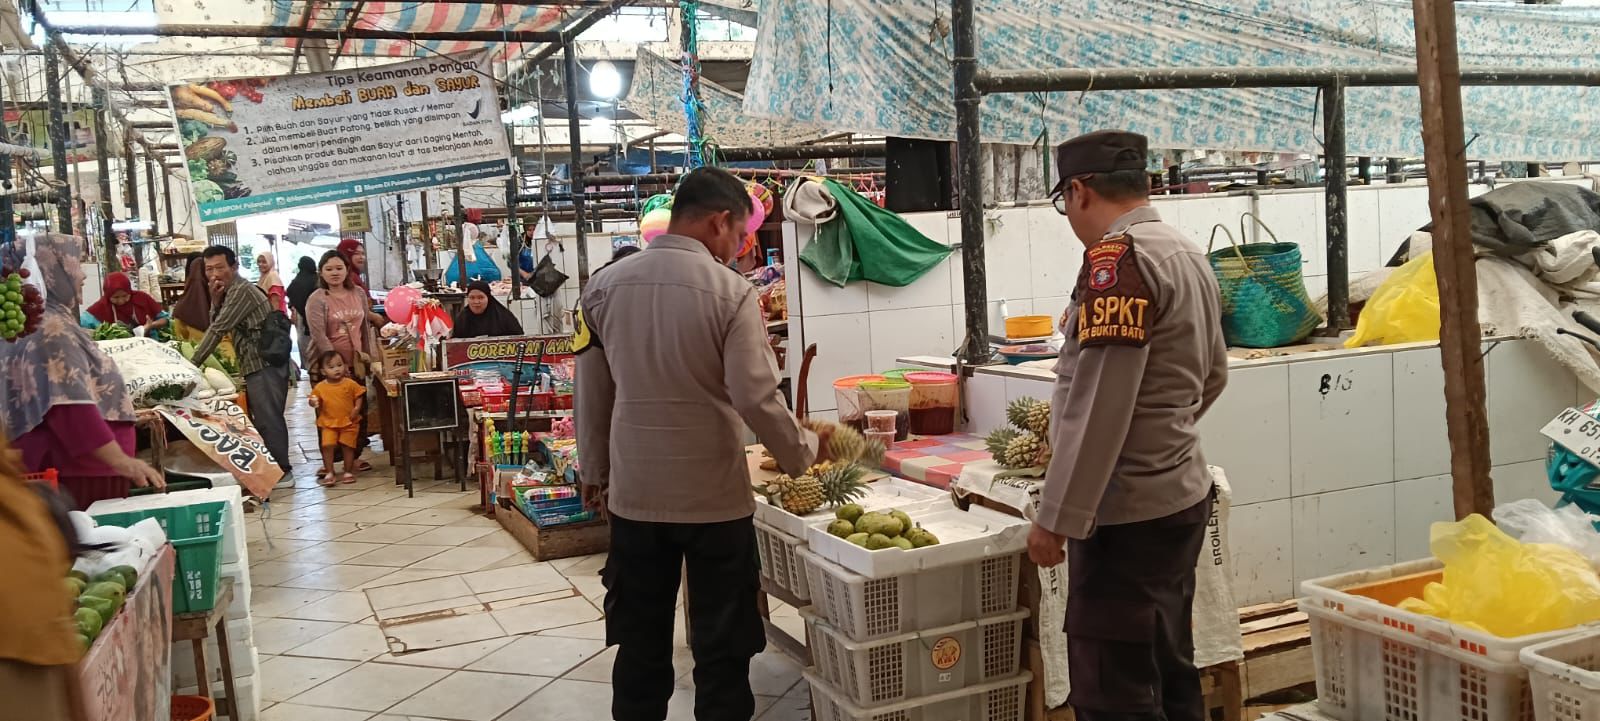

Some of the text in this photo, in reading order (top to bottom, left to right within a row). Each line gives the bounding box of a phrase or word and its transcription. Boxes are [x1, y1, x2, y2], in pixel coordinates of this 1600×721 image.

[325, 60, 478, 87] Tips Keamanan Pangan
[292, 74, 480, 111] Membeli BUAH dan SAYUR
[244, 126, 254, 135] 1.
[275, 121, 298, 131] Buah
[299, 119, 316, 128] dan
[317, 115, 344, 127] Sayur
[346, 112, 368, 123] yang
[393, 105, 419, 115] Rusak
[426, 101, 455, 111] Memar
[246, 137, 257, 146] 2.
[260, 135, 277, 144] Jika
[278, 131, 316, 142] membeli
[402, 115, 423, 127] yang
[424, 112, 461, 122] disimpan
[251, 158, 261, 167] 3.
[264, 154, 303, 166] Pisahkan
[337, 145, 359, 155] Buah
[360, 143, 376, 152] dan
[377, 139, 403, 151] Sayur
[405, 136, 423, 146] dari
[423, 133, 452, 144] Daging
[262, 135, 362, 155] dalam lemari pendingin
[267, 165, 296, 176] olahan
[297, 160, 330, 172] unggas
[331, 157, 348, 167] dan
[349, 152, 387, 164] makanan
[388, 149, 405, 159] laut
[407, 147, 416, 156] di
[417, 146, 431, 155] tas
[432, 140, 471, 154] belanjaan
[473, 137, 494, 148] Anda
[1093, 296, 1149, 327] SPKT
[1091, 325, 1119, 337] BUKIT
[1121, 325, 1145, 340] BATU
[468, 340, 545, 359] GORENAN
[1557, 409, 1581, 426] KH
